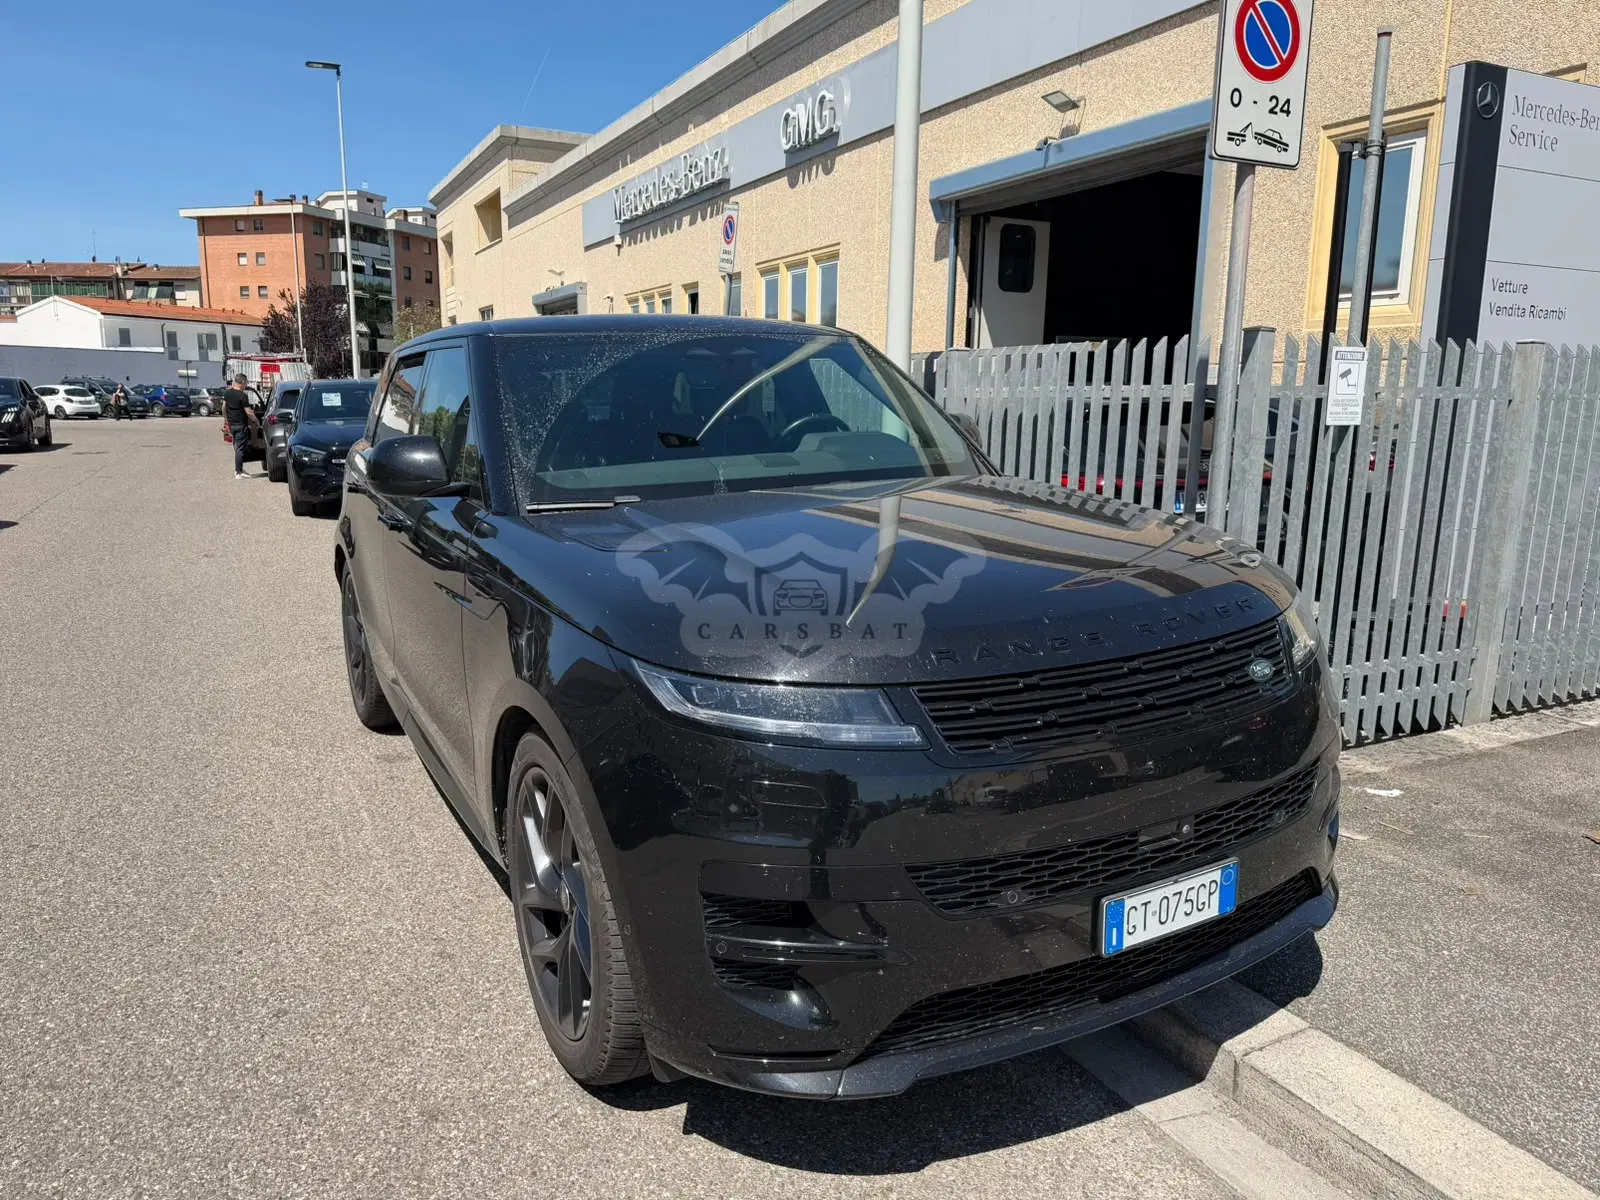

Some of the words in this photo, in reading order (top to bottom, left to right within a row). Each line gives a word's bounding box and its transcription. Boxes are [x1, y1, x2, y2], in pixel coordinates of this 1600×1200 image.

[1230, 88, 1242, 108] 0
[1268, 95, 1291, 117] 24
[1509, 124, 1558, 152] Service
[613, 148, 728, 223] Mercedes-Benz
[1491, 277, 1528, 294] Vetture
[1489, 301, 1526, 318] Vendita
[1529, 304, 1567, 321] Ricambi
[929, 631, 1103, 667] RANGE
[1132, 597, 1255, 636] ROVER
